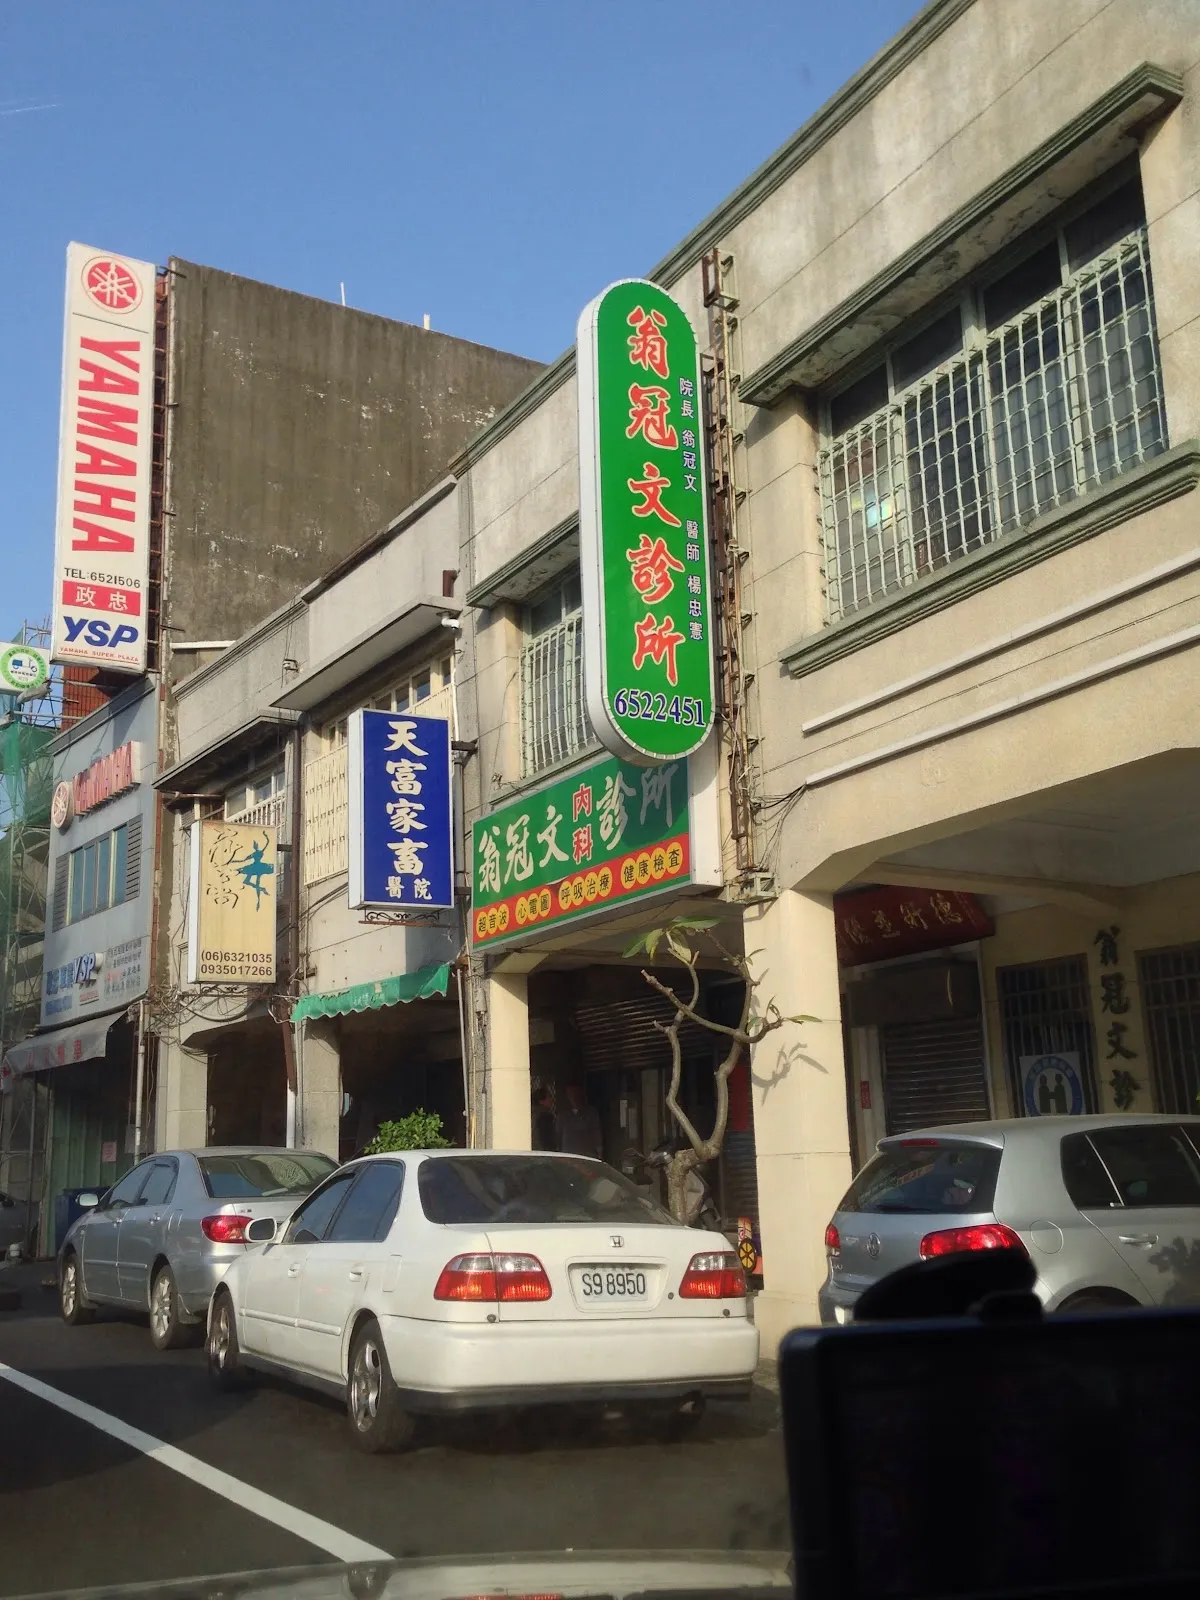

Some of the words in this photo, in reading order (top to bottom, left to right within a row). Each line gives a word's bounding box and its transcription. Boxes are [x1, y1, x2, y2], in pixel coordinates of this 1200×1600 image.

[678, 377, 694, 419] 院長
[72, 336, 140, 553] YAMAHA
[681, 429, 698, 493] 翁冠文
[626, 305, 686, 687] 翁冠文診所
[686, 520, 700, 562] 醫師
[64, 567, 141, 589] TEL:6521506
[75, 586, 129, 611] 政忠
[63, 615, 139, 649] YSP
[60, 646, 88, 655] YAMAHA
[117, 654, 139, 662] PLAZA
[614, 688, 707, 727] 6522451
[384, 720, 429, 876] 天富家畜
[478, 804, 570, 894] 翁冠文
[596, 764, 679, 851] 診所
[385, 875, 433, 900] 醫院
[478, 909, 508, 933] 超音波
[517, 893, 549, 919] 心電圖
[561, 873, 610, 904] 呼吸治療
[623, 848, 681, 884] 健康檢查
[73, 952, 96, 984] YSP
[201, 950, 273, 964] (06)6321035
[201, 964, 273, 976] 0935017266
